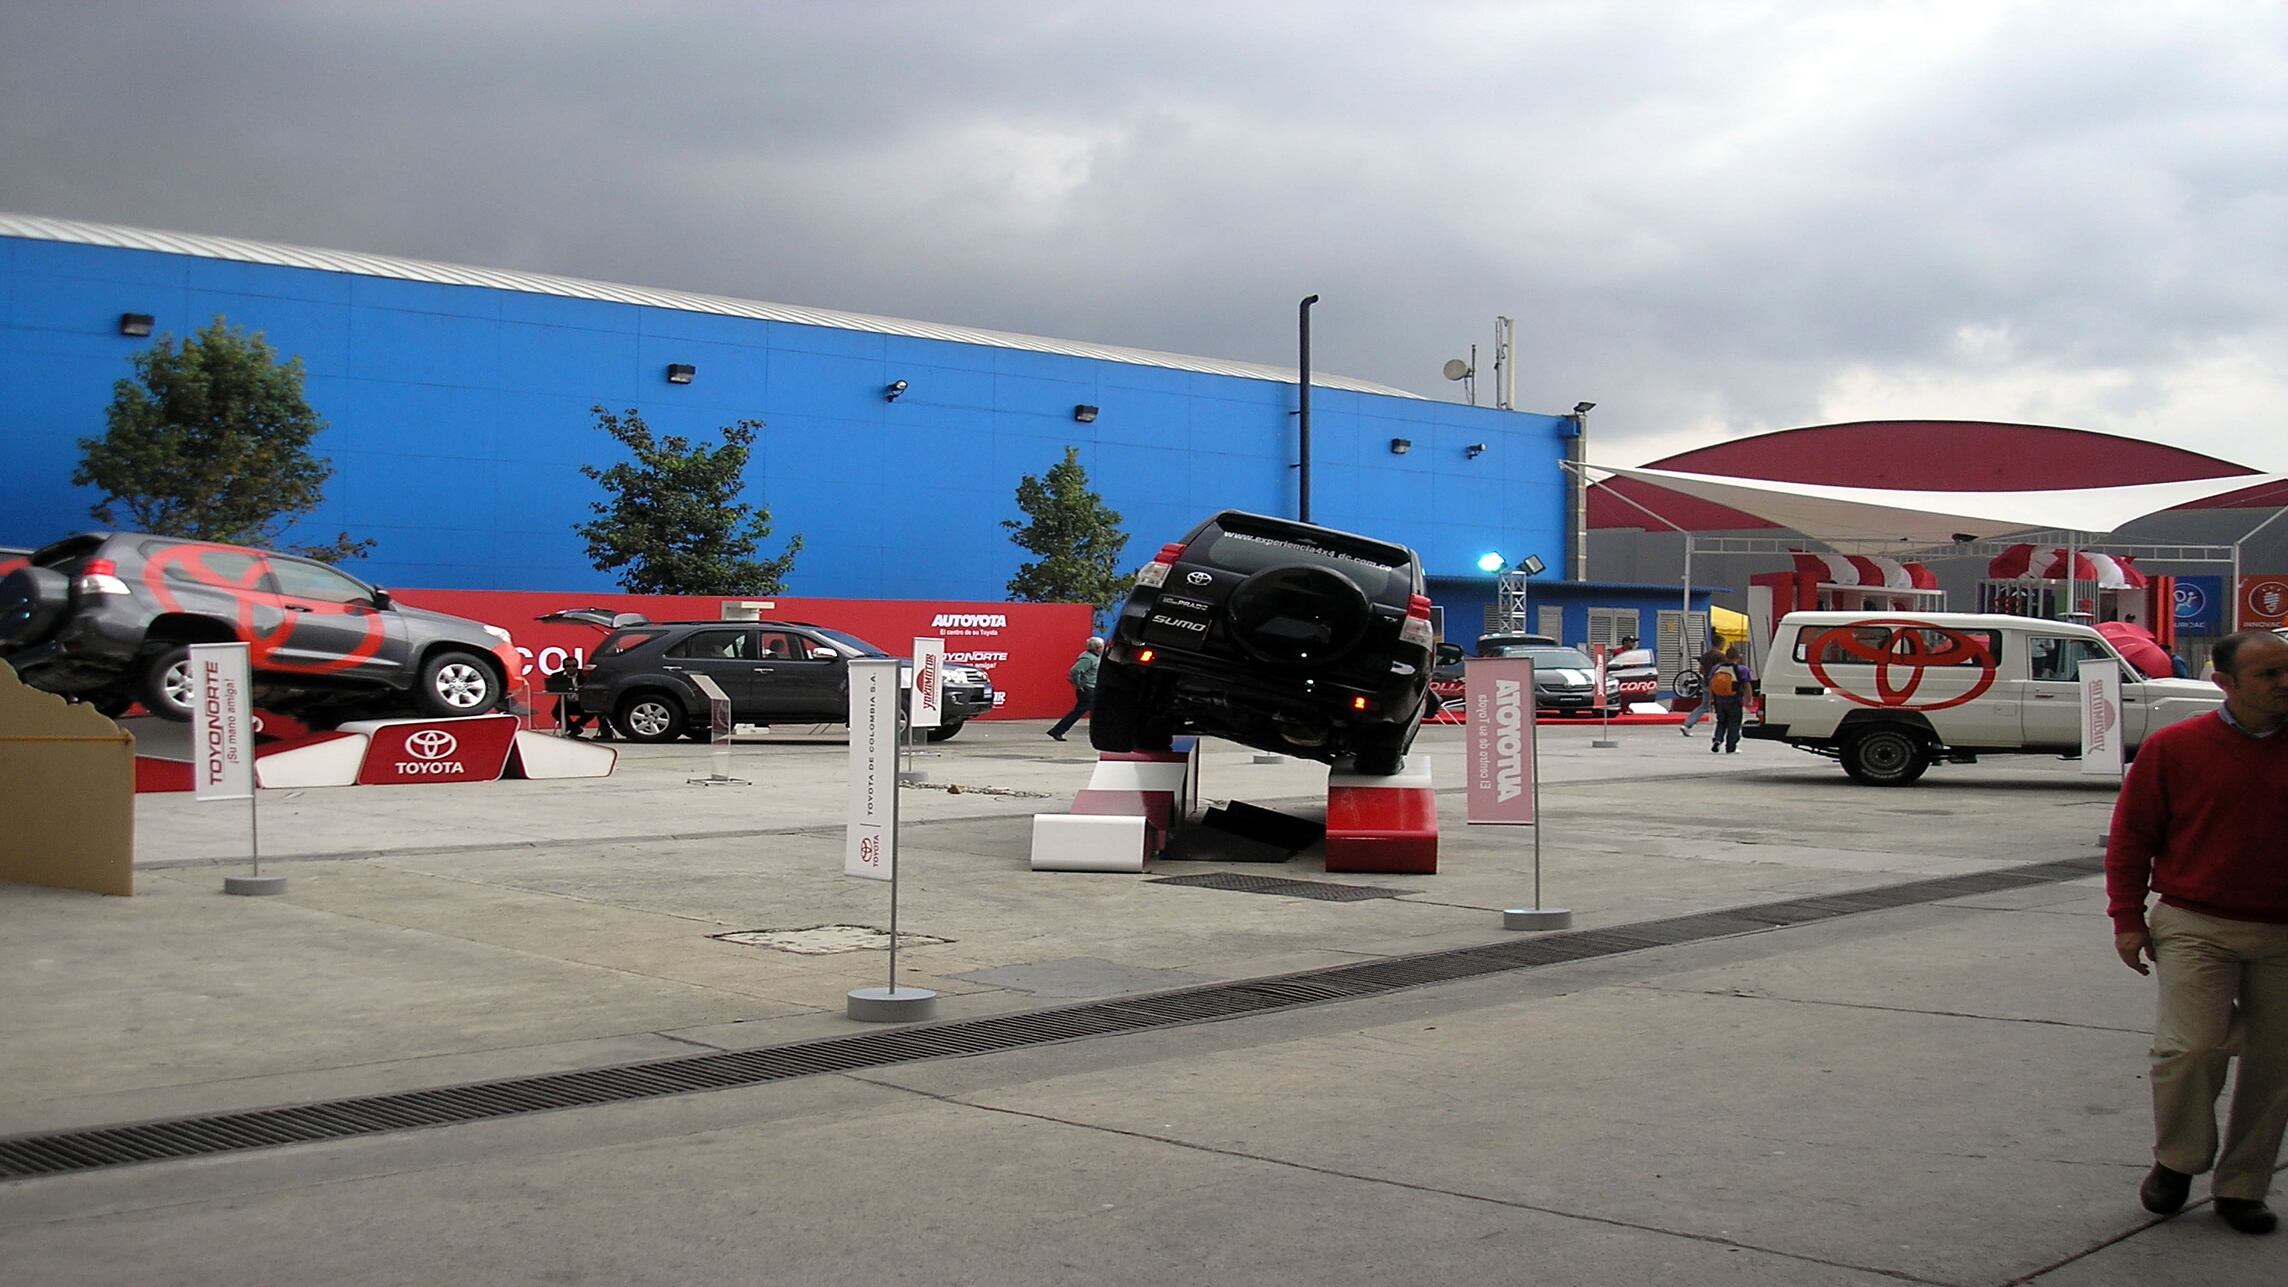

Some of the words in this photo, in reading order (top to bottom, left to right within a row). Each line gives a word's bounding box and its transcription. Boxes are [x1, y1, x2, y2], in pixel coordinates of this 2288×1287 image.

[931, 614, 1007, 627] AUTOYOTA
[1152, 614, 1207, 632] SUMO
[943, 651, 1008, 662] OYONORTE
[1620, 681, 1657, 691] CORO
[224, 678, 238, 714] amiga!
[206, 660, 224, 786] TOYONORTE
[227, 715, 238, 745] mano
[395, 761, 465, 774] TOYOTA
[868, 756, 875, 771] DE
[867, 773, 875, 817] TOYOTA
[872, 834, 880, 867] TOYOTA
